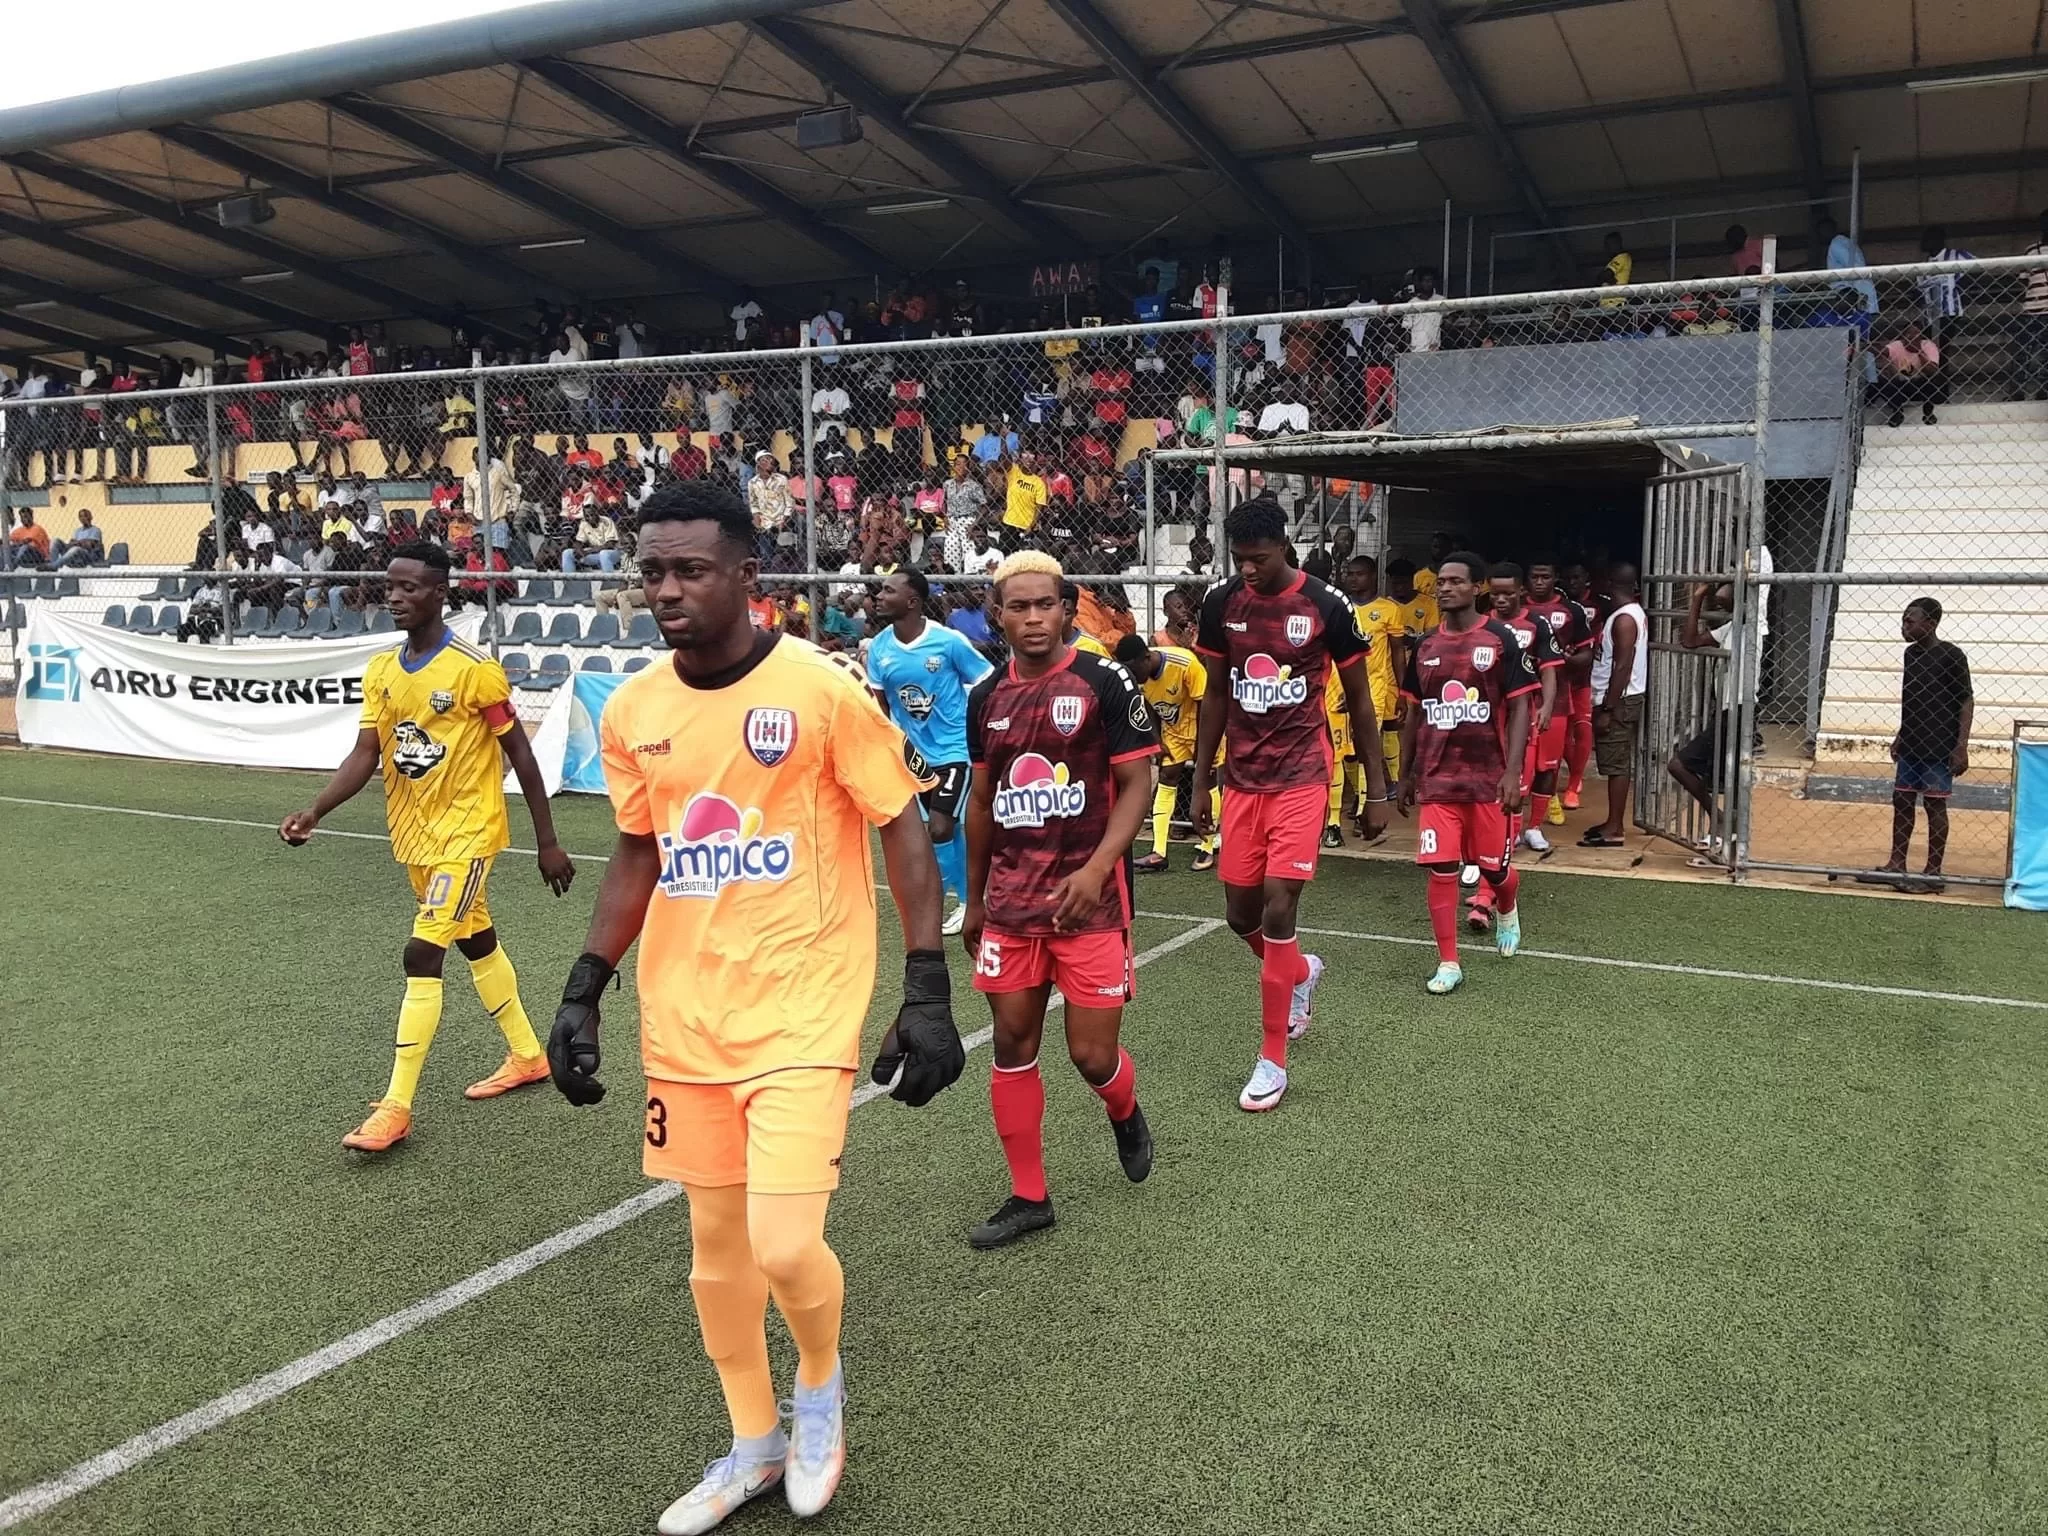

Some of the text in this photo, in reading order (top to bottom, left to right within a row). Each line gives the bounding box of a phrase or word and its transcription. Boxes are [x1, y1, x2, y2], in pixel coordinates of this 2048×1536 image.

[1032, 262, 1086, 286] AWA
[90, 667, 177, 698] AIRU
[1424, 700, 1489, 726] Tampico
[637, 738, 670, 754] capelli
[996, 788, 1084, 822] ampico
[668, 880, 713, 893] IRRESISTIBLE
